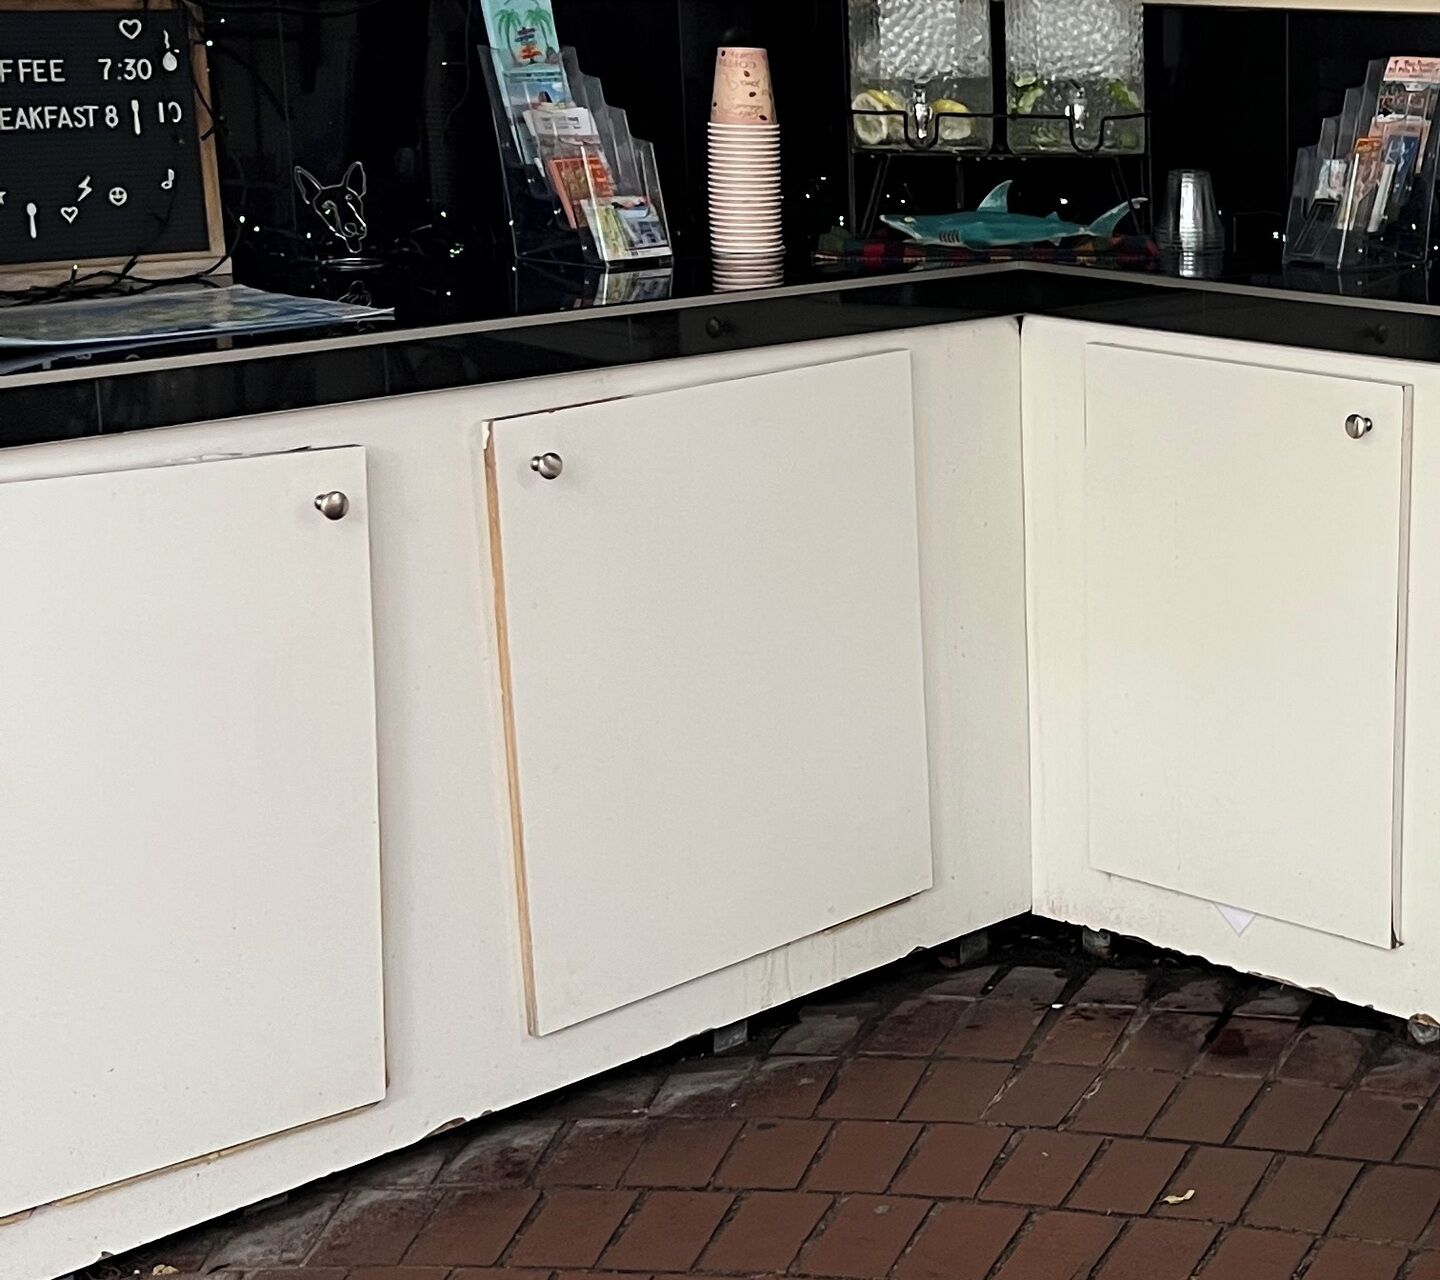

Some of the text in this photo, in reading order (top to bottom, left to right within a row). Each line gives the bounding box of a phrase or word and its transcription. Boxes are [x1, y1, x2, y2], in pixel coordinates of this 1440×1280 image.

[0, 58, 152, 84] FFEE 7:30
[0, 105, 99, 131] EAKFAST
[105, 104, 119, 128] 8
